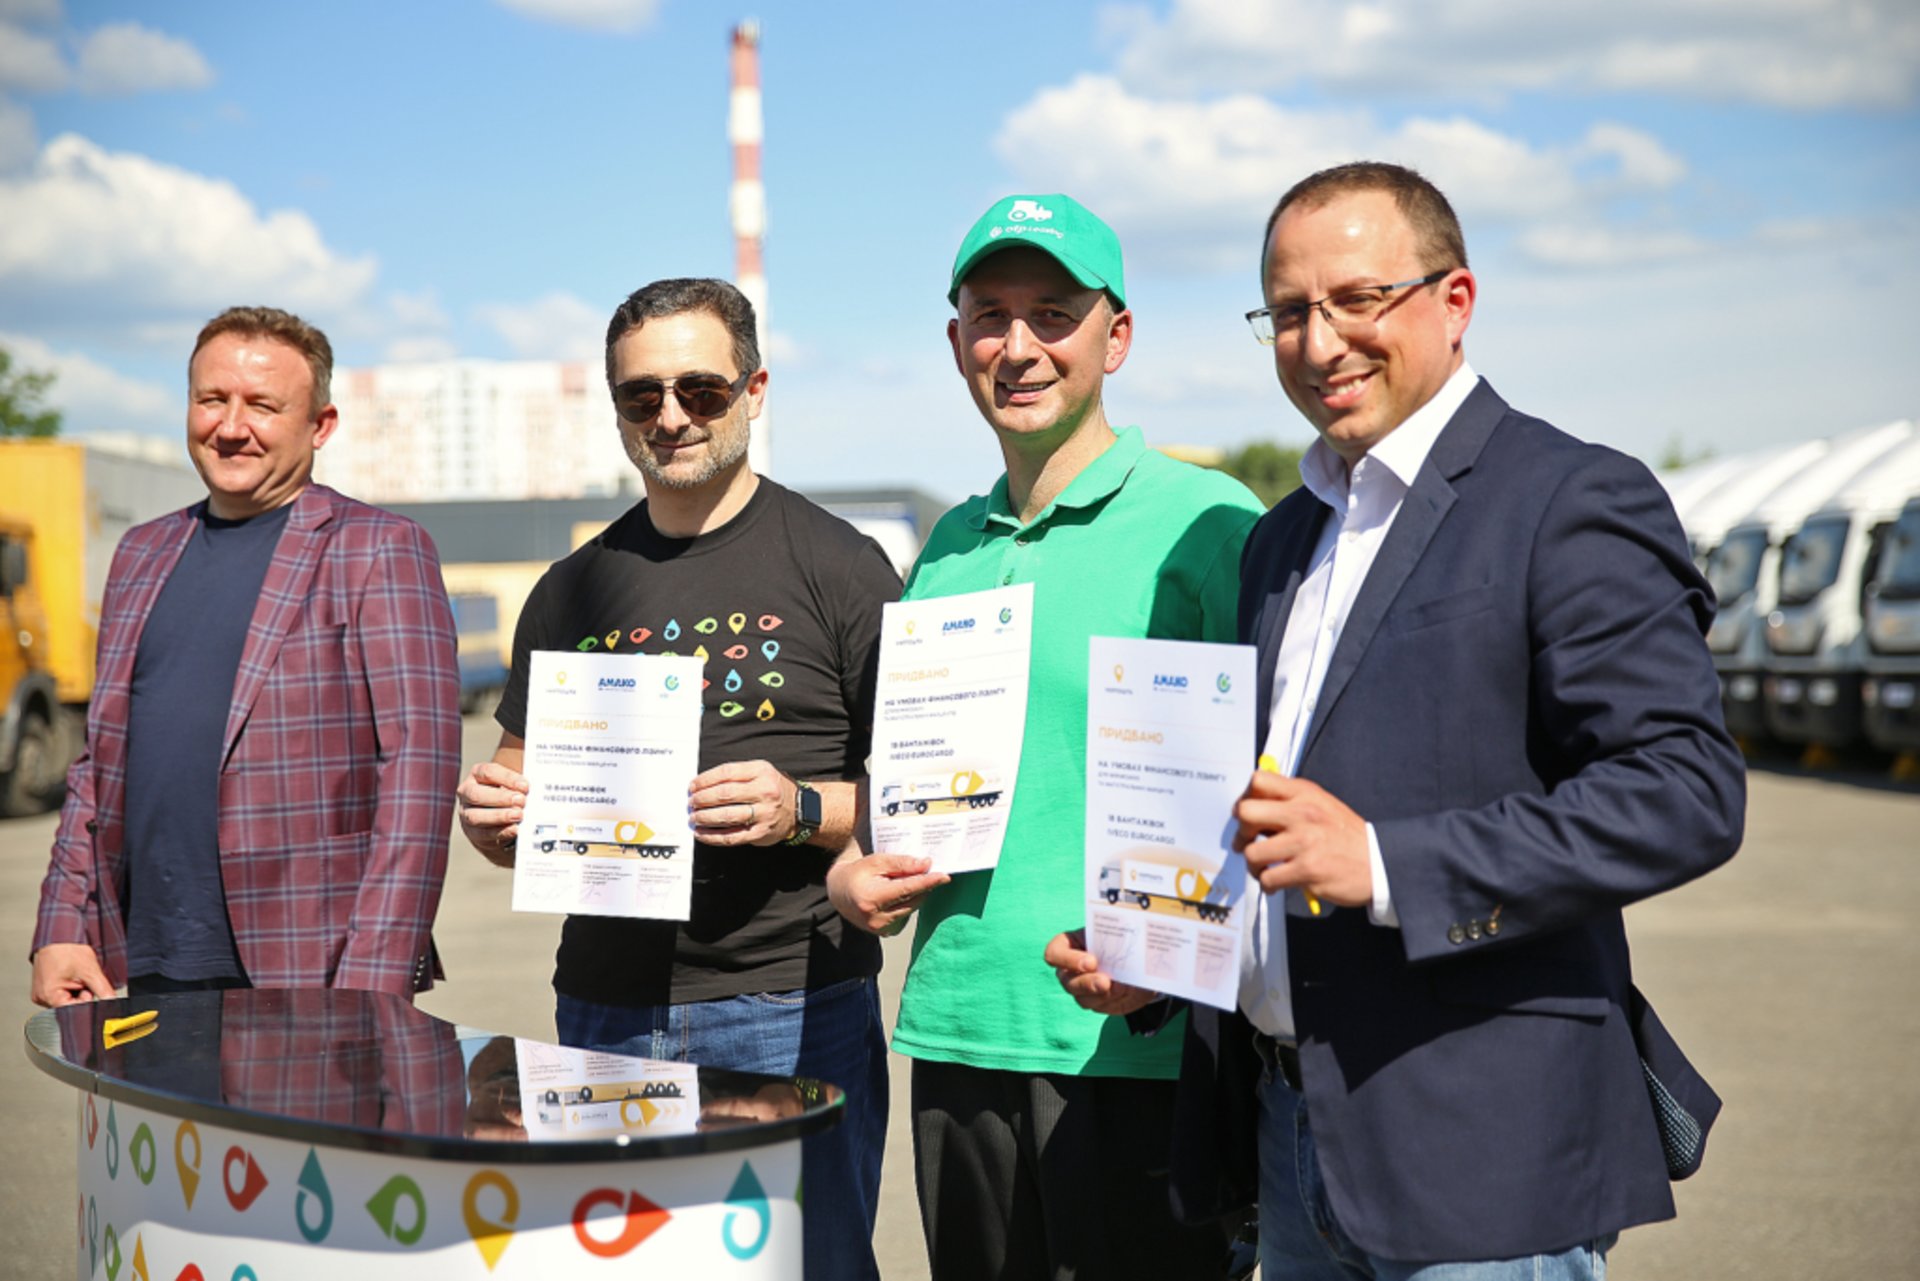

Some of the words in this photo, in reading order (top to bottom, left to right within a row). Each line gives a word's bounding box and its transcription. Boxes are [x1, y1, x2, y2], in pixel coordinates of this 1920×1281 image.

[888, 667, 950, 683] ПРИДБАНО
[538, 718, 609, 731] ПРИДБАНО
[1099, 726, 1164, 745] ПРИДБАНО
[1130, 832, 1176, 845] EUROCARGO
